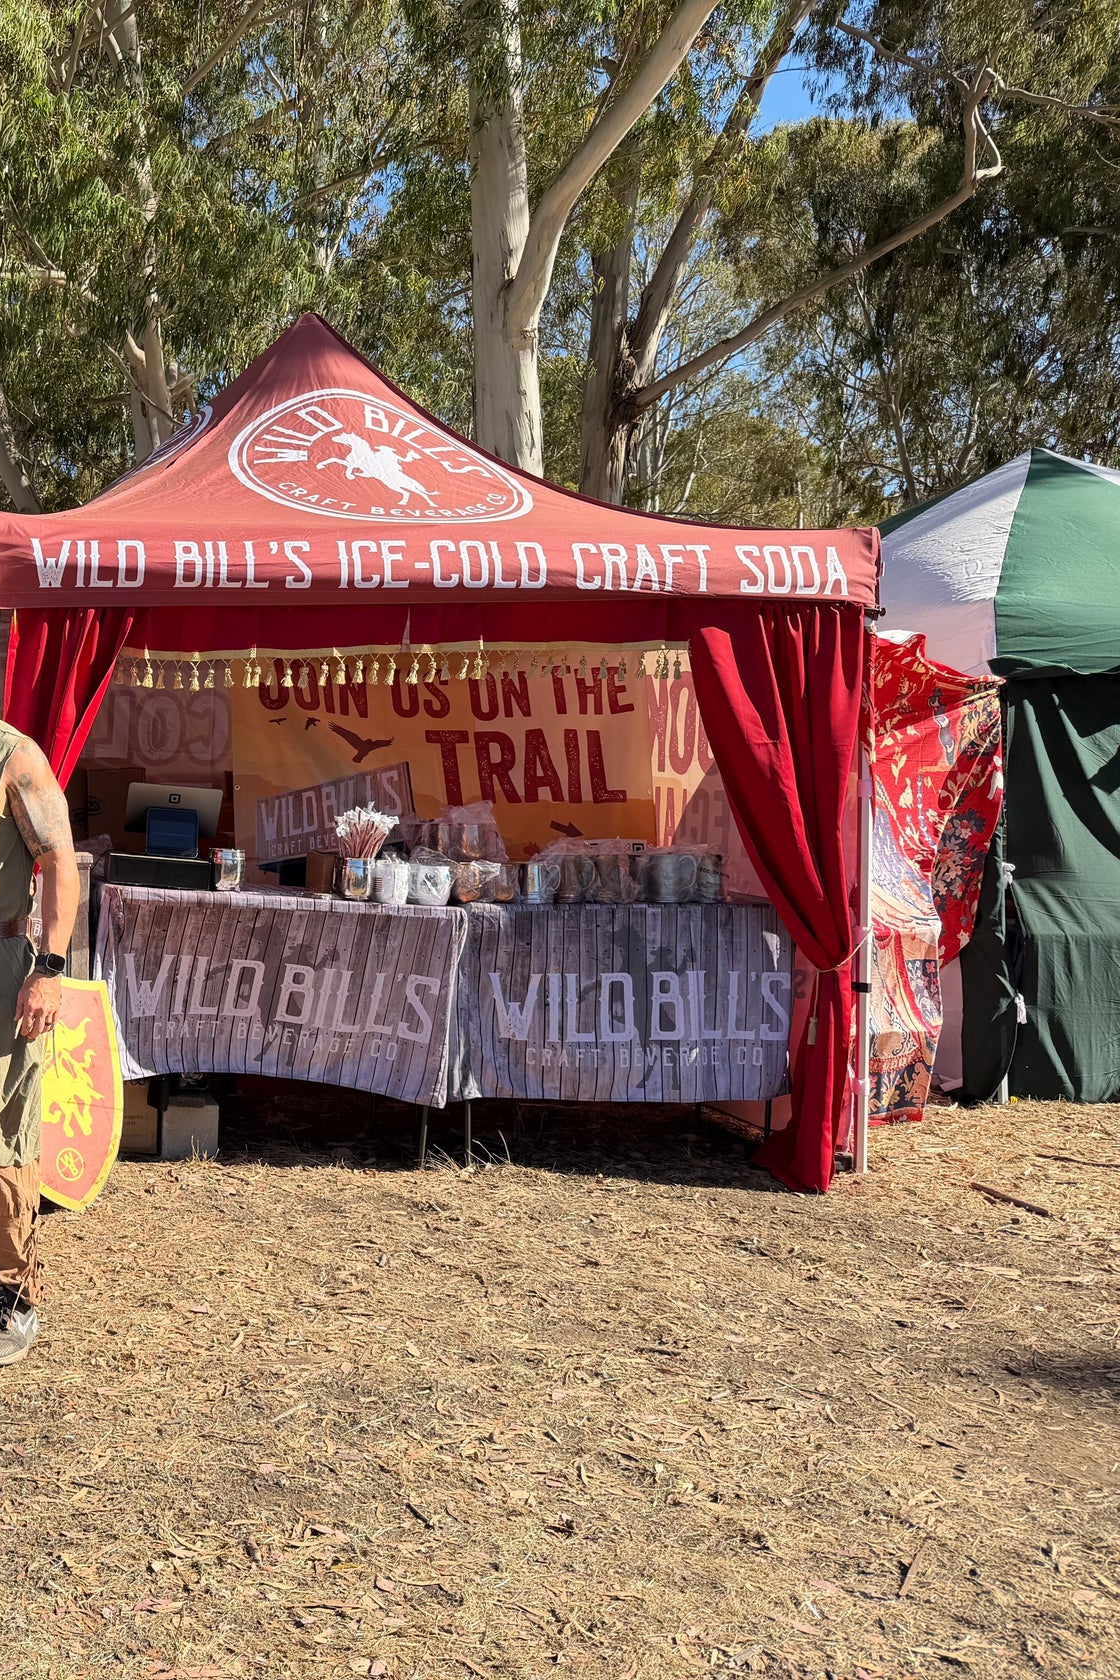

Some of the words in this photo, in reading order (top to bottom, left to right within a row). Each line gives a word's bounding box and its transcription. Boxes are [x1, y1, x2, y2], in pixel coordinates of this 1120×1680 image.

[253, 405, 344, 465] WILD
[364, 404, 493, 478] BILL'S
[278, 481, 357, 510] CRAFT
[370, 503, 496, 518] BEVERAGE
[30, 537, 147, 588] WILD
[173, 539, 313, 589] BILL'S
[335, 538, 548, 589] ICE-COLD
[571, 541, 711, 593] CRAFT
[734, 544, 850, 596] SODA
[258, 657, 369, 718] JOIN
[390, 667, 450, 718] US
[468, 671, 531, 721] ON
[542, 665, 634, 715] THE
[425, 728, 627, 806] TRAIL
[260, 790, 318, 842] WILD
[271, 839, 302, 858] CRAFT
[309, 832, 337, 850] BEVE
[124, 953, 265, 1019] WILD
[273, 962, 441, 1045] BILL'S
[488, 971, 635, 1042] WILD
[649, 970, 791, 1041] BILL'S
[152, 1020, 221, 1041] CRAFT
[525, 1047, 602, 1068] CRAFT
